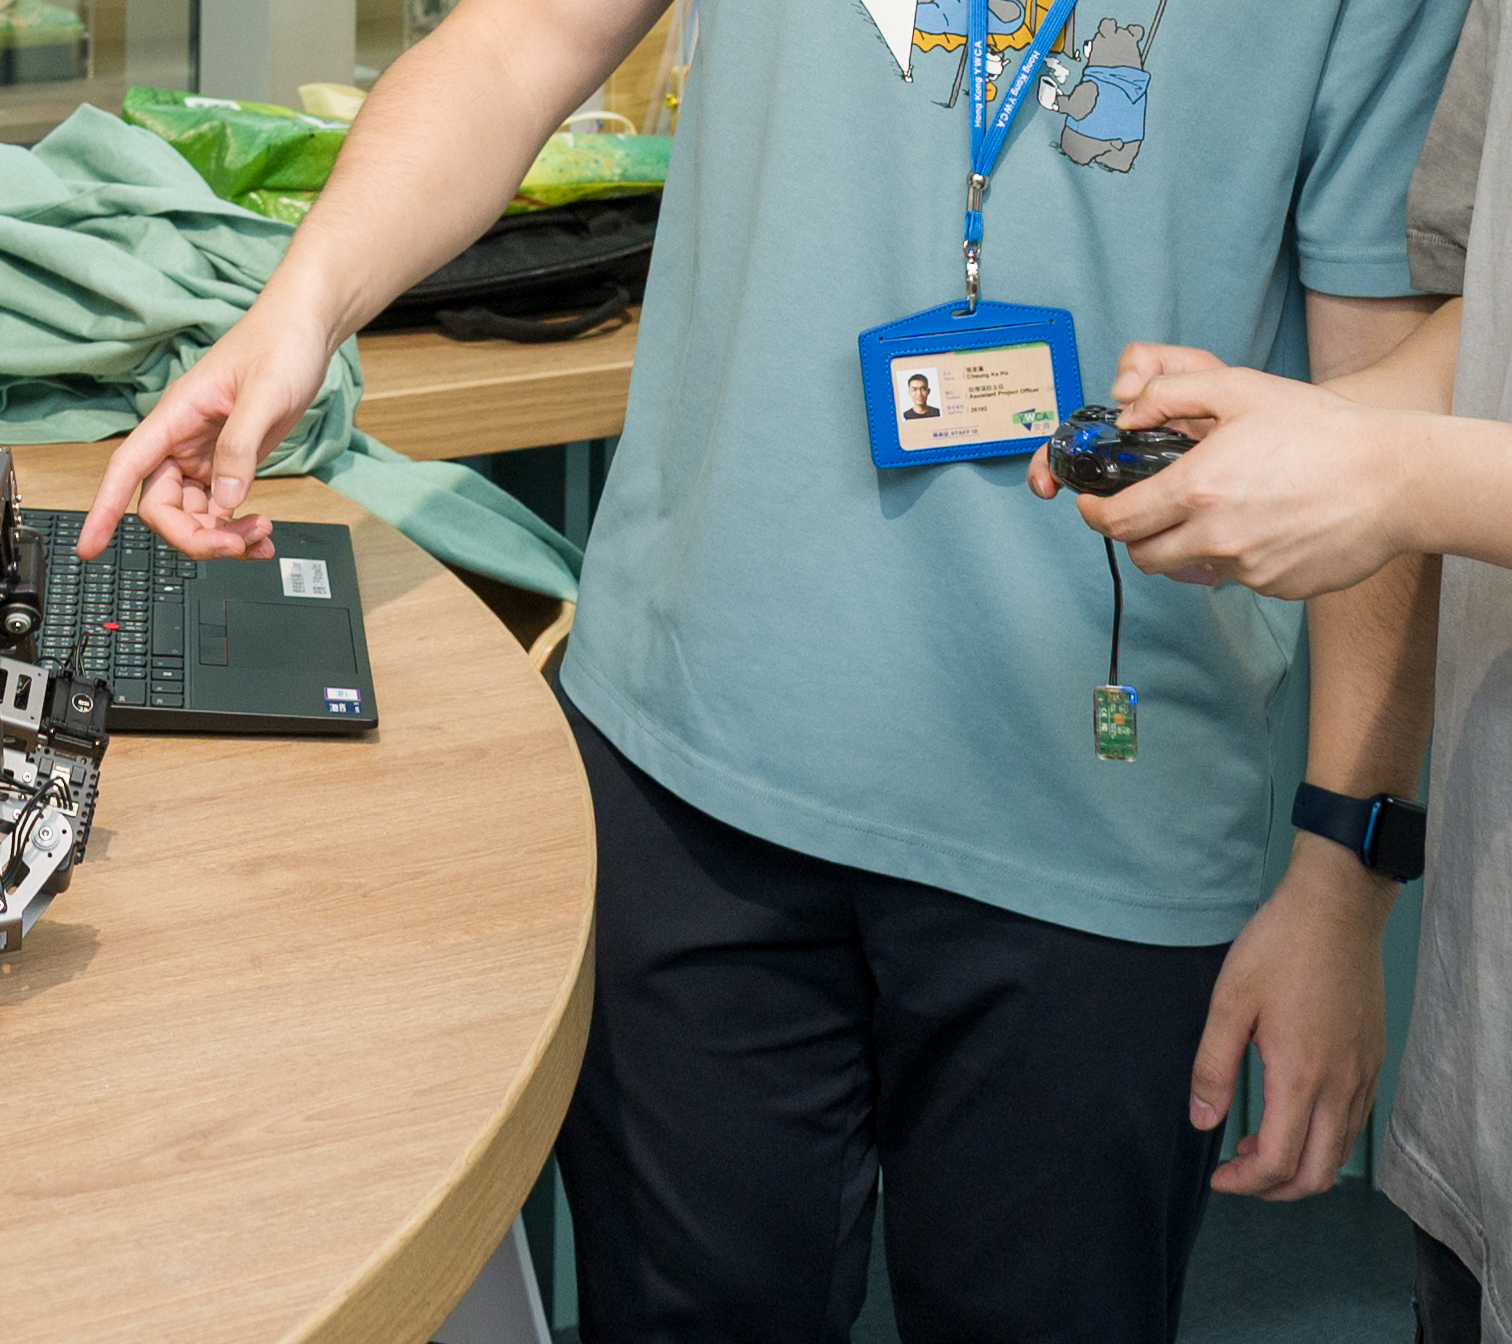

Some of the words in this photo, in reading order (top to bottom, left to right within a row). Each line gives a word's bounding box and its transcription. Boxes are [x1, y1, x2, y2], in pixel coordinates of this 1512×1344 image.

[974, 40, 982, 75] YWCA
[1022, 50, 1041, 74] Hong
[974, 77, 983, 101] Kong
[1010, 73, 1028, 96] Kong
[974, 103, 983, 128] Hong
[996, 97, 1016, 128] YWCA
[1018, 412, 1050, 421] YWCA
